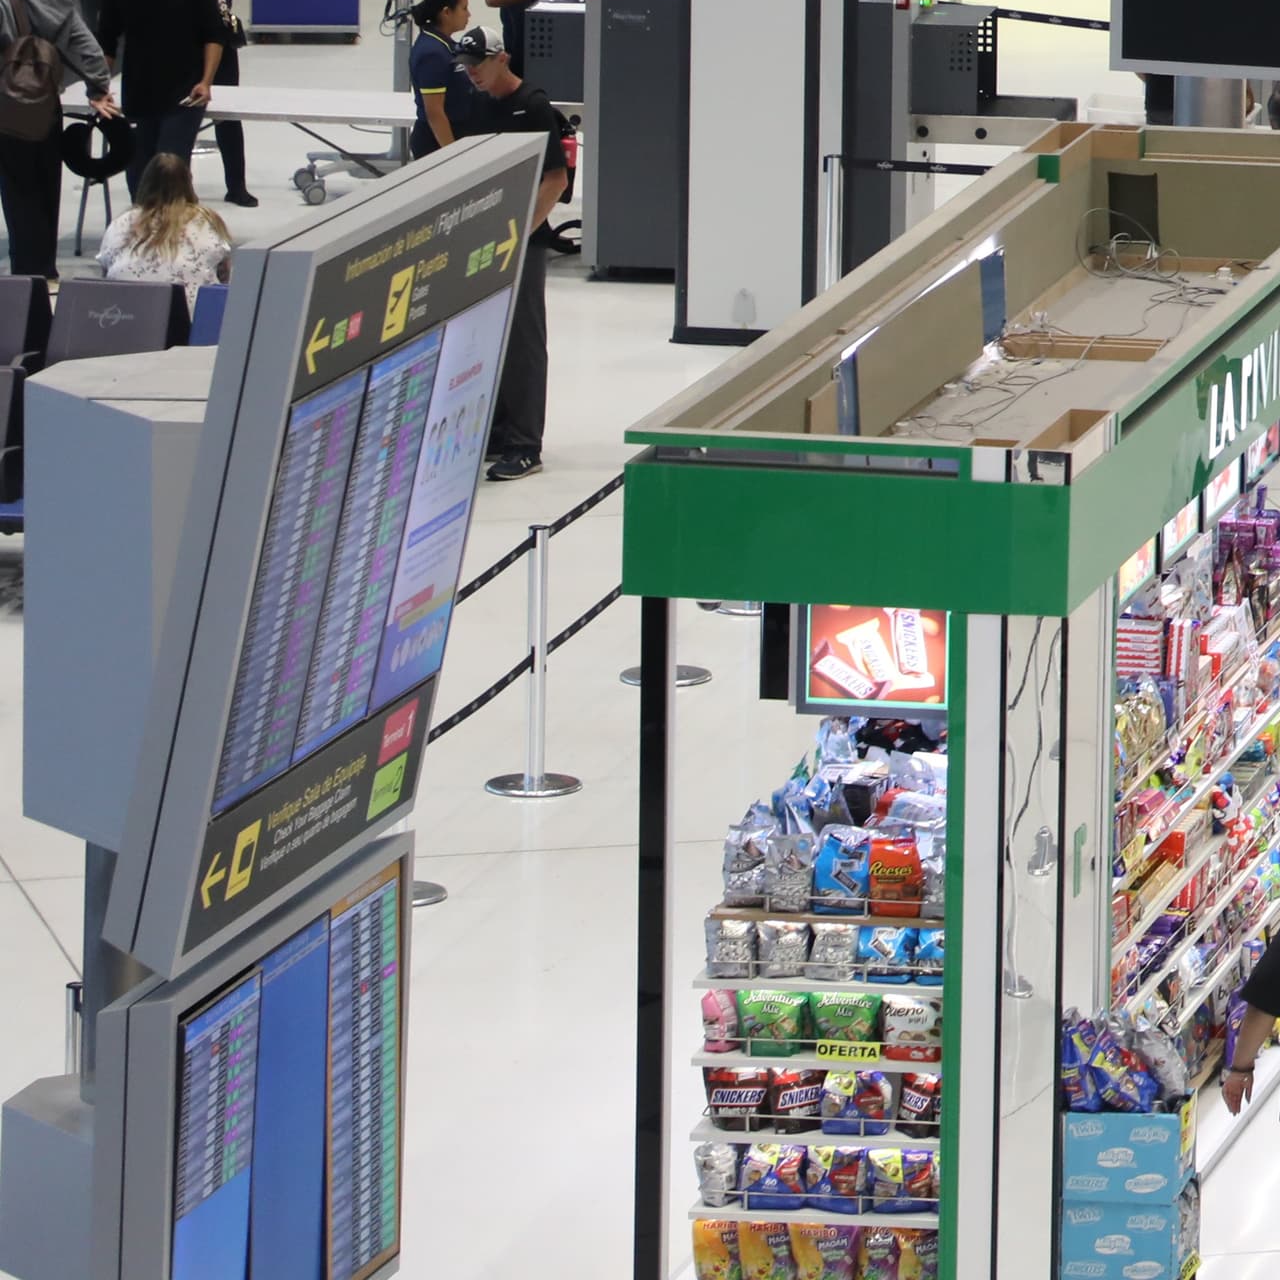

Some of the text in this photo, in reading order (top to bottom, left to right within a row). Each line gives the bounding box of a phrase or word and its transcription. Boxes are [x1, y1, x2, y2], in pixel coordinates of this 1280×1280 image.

[438, 207, 462, 236] Flight
[416, 251, 449, 282] Puertas
[1209, 371, 1236, 460] LA
[405, 709, 414, 738] 1
[392, 764, 403, 794] 2
[267, 753, 368, 832] Verifique Sala de Equipaje
[274, 823, 293, 845] Check
[870, 861, 912, 875] Reese's
[744, 992, 807, 1007] Adventure
[817, 993, 873, 1009] Adventure
[762, 1003, 779, 1014] Mix
[835, 1005, 853, 1017] Mix
[817, 1043, 878, 1059] OFERTA
[713, 1087, 765, 1104] SNICKERS
[800, 1228, 837, 1238] HARIBO
